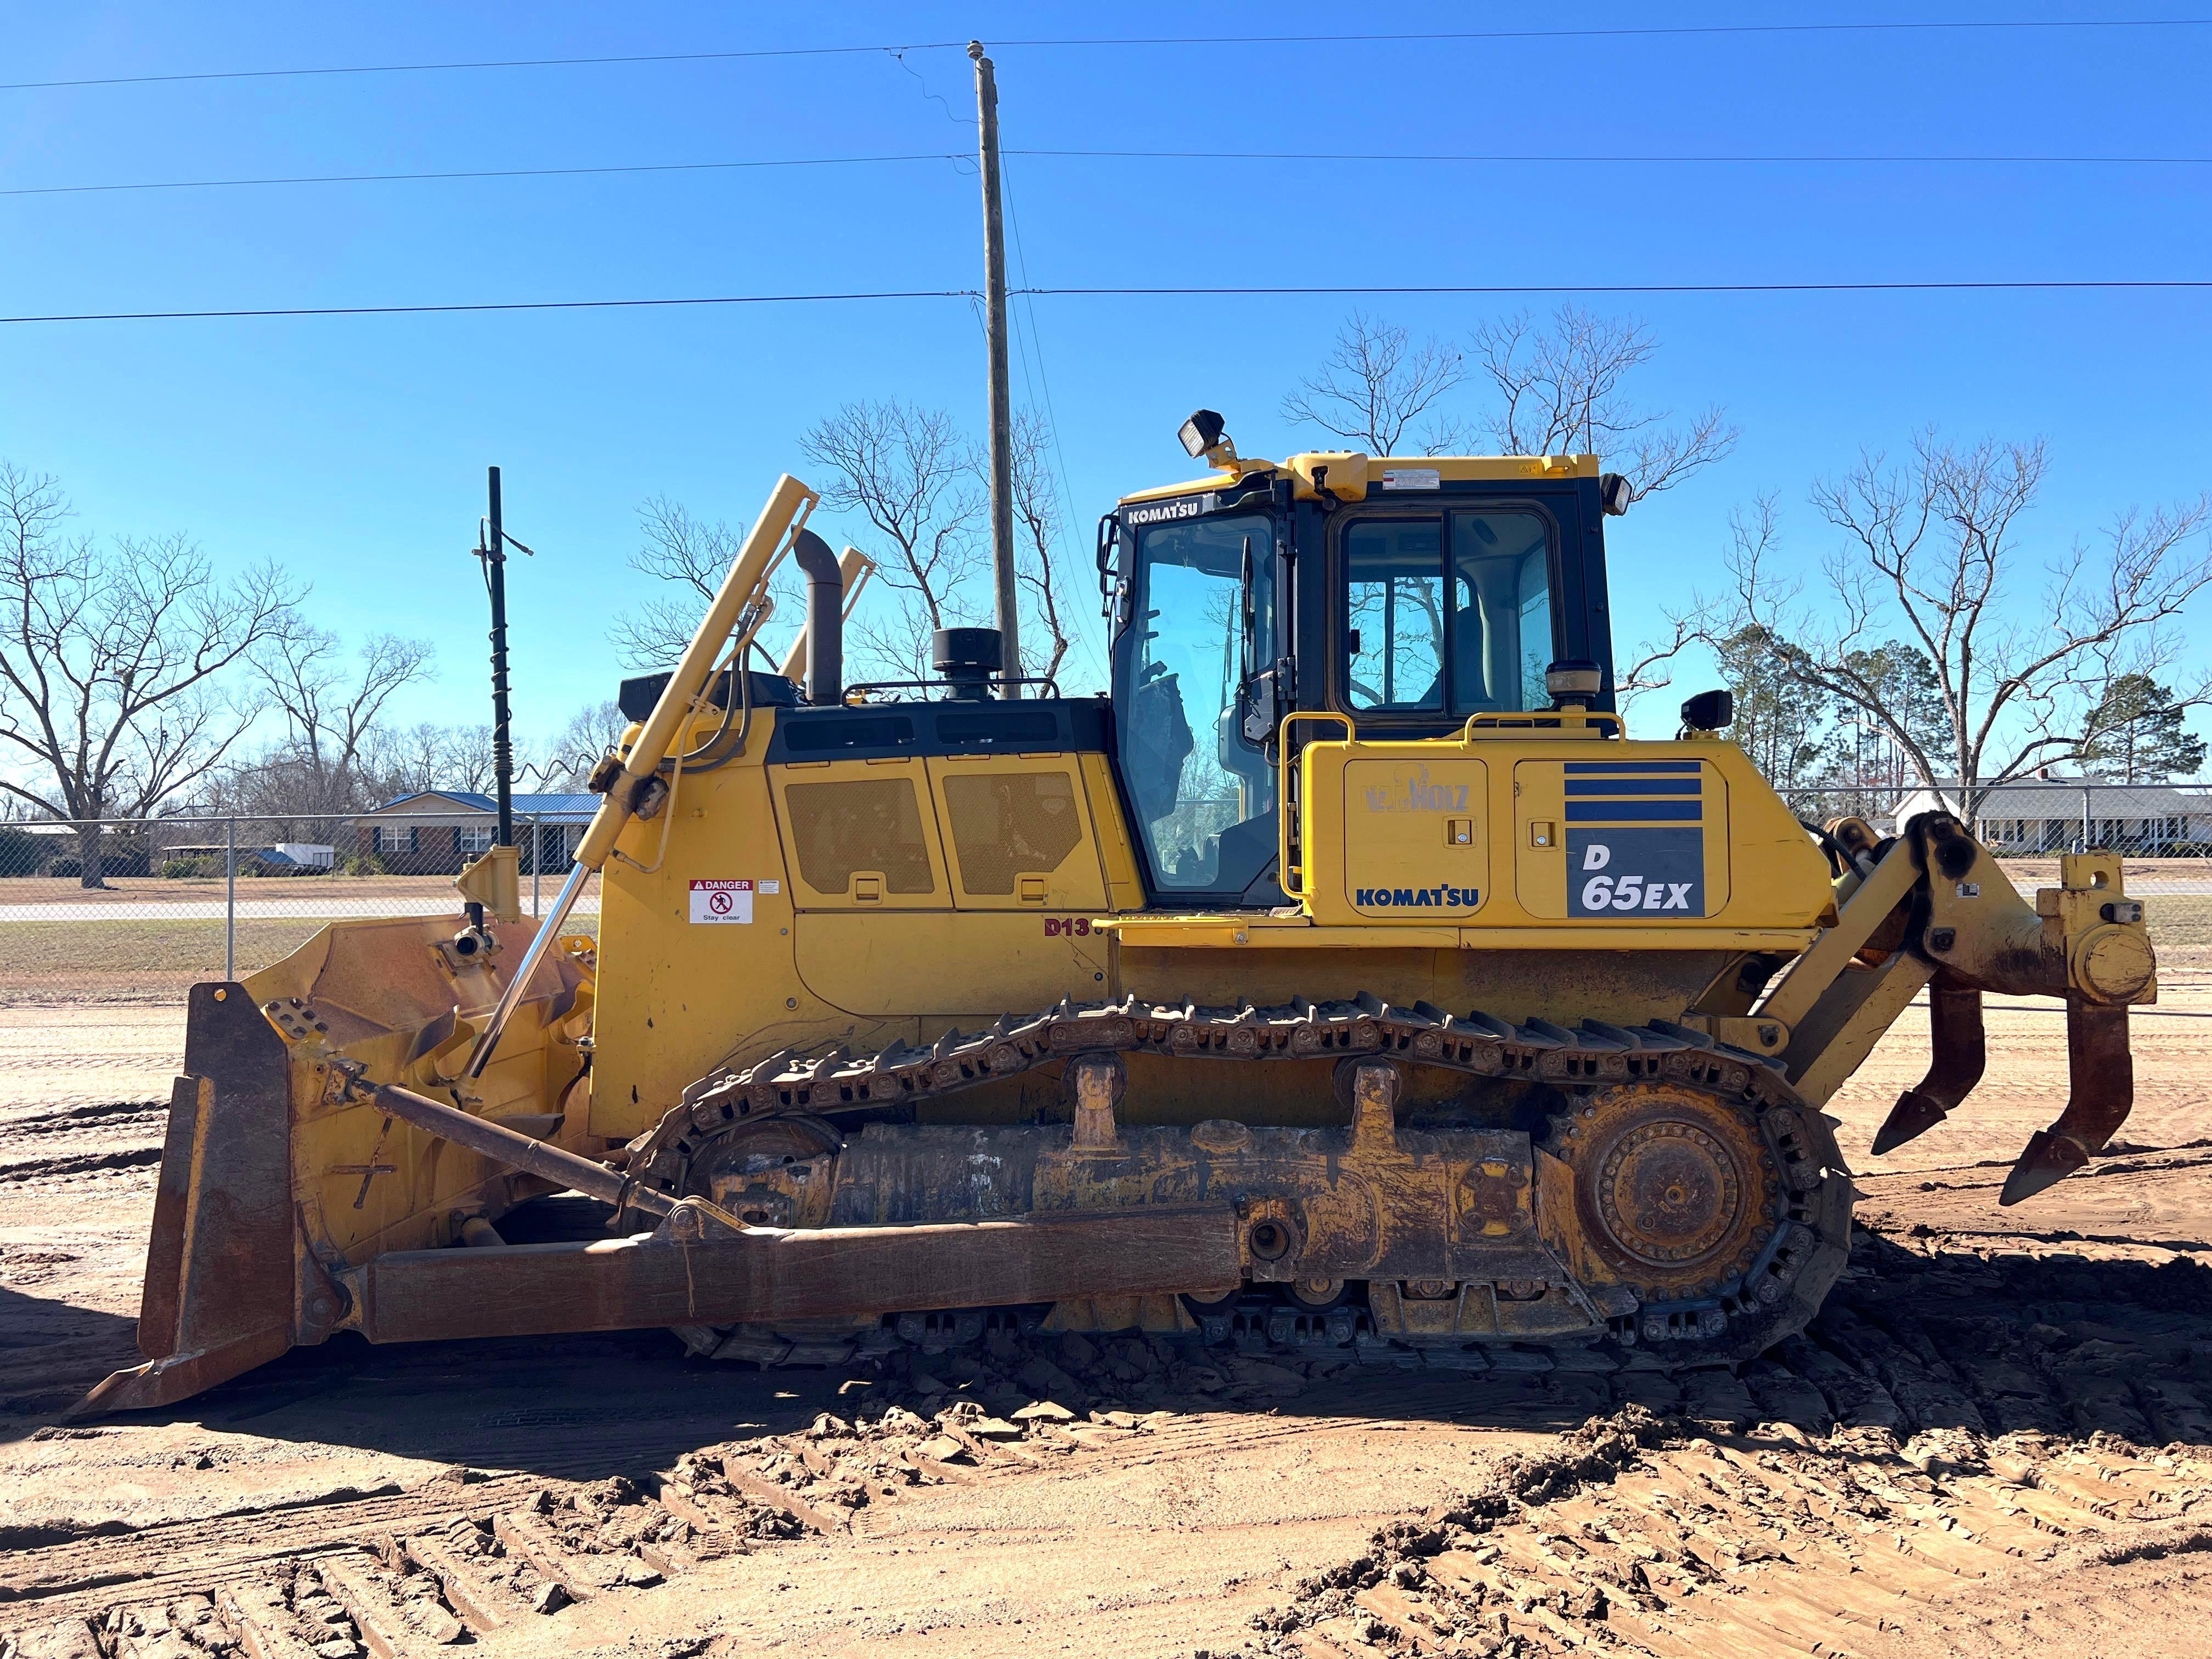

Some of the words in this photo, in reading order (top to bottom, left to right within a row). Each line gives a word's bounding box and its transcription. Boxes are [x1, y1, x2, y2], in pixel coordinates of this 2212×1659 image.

[1128, 501, 1198, 524] KOMATSU
[1582, 844, 1610, 870] D
[705, 881, 749, 890] DANGER
[1356, 883, 1479, 907] KOMATSU
[1582, 875, 1694, 911] 65EX
